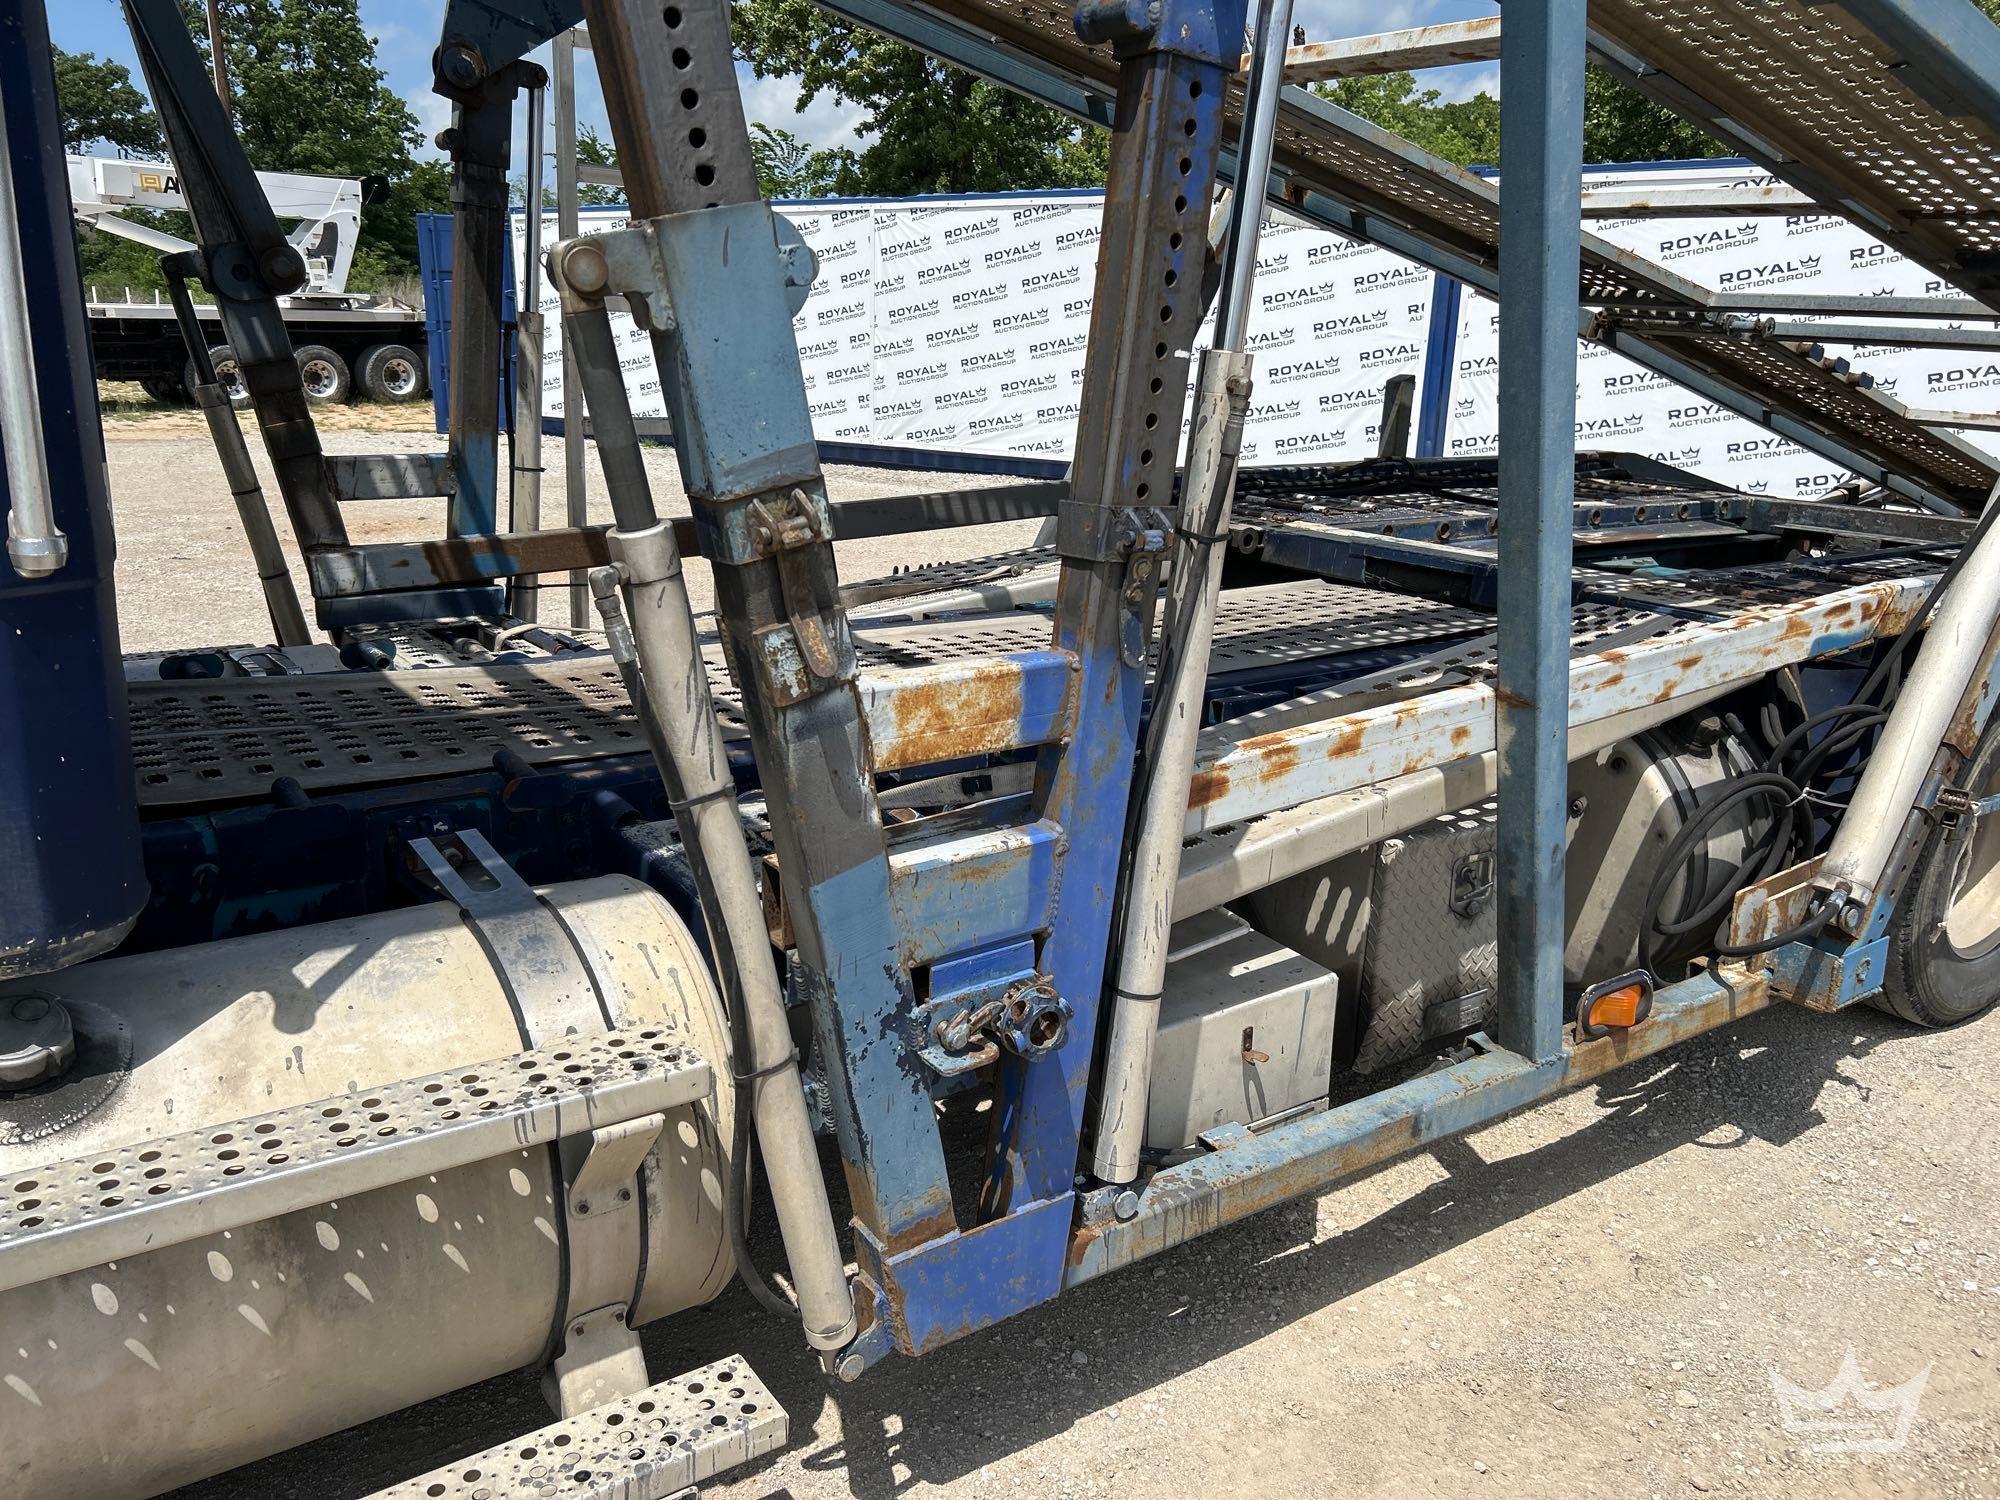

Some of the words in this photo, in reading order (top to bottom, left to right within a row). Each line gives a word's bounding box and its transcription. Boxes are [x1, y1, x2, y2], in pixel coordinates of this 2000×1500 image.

[834, 217, 860, 228] AUCTION
[912, 211, 940, 221] AUCTION
[1015, 216, 1045, 227] AUCTION
[1047, 208, 1072, 219] GROUP
[877, 222, 898, 231] GROUP
[944, 222, 987, 240] ROYAL
[1787, 220, 1844, 236] AUCTION
[946, 235, 975, 246] AUCTION
[976, 228, 1000, 238] GROUP
[1056, 226, 1101, 245] ROYAL
[1660, 229, 1737, 252] ROYAL
[817, 244, 846, 258] OYAL
[881, 240, 920, 256] ROYAL
[1058, 240, 1089, 251] AUCTION
[1308, 240, 1360, 258] ROYA
[1661, 245, 1714, 261] AUCTION
[1716, 236, 1758, 250] GROUP
[819, 256, 836, 264] CTION
[837, 250, 858, 259] GROUP
[882, 252, 908, 262] AUCTION
[910, 246, 932, 255] GROUP
[985, 245, 1029, 262] ROYAL
[986, 258, 1016, 269] AUCTION
[1018, 252, 1042, 262] GROUP
[1309, 252, 1348, 266] AUCTION
[841, 269, 870, 283] ROYA
[918, 262, 959, 280] ROYAL
[920, 274, 947, 285] AUCTION
[948, 268, 972, 278] GROUP
[1259, 266, 1289, 276] GROUP
[1354, 267, 1413, 286] ROYAL
[1720, 261, 1798, 284] ROYAL
[843, 280, 868, 289] AUCTION
[874, 279, 894, 290] YAL
[1022, 270, 1067, 288] ROYAL
[1024, 283, 1054, 294] AUCTION
[1056, 277, 1080, 287] GROUP
[1721, 278, 1774, 293] AUCTION
[1778, 270, 1822, 282] GROUP
[810, 289, 830, 297] GROUP
[886, 285, 906, 294] GROUP
[1356, 282, 1396, 294] AUCTION
[952, 288, 996, 304] ROYAL
[954, 300, 984, 310] AUCTION
[984, 294, 1008, 304] GROUP
[1263, 286, 1318, 305] ROYAL
[1064, 298, 1092, 312] ROY
[1264, 301, 1302, 312] AUCTION
[1304, 294, 1335, 305] GROUP
[818, 306, 855, 320] ROYAL
[888, 305, 929, 318] ROYAL
[890, 315, 917, 325] AUCTION
[919, 310, 940, 320] GROUP
[1066, 310, 1092, 319] AUCTIO
[820, 318, 844, 326] AUCTION
[846, 312, 866, 320] GROUP
[993, 312, 1036, 328] ROYAL
[994, 324, 1024, 334] AUCTION
[1026, 318, 1050, 328] GROUP
[1314, 314, 1372, 332] ROYAL
[926, 326, 967, 342] ROYAL
[1314, 328, 1354, 340] AUCTION
[1356, 322, 1388, 333] GROUP
[928, 338, 955, 348] AUCTION
[957, 334, 980, 343] GROUP
[1030, 337, 1074, 353] ROYAL
[1245, 332, 1280, 346] YAL
[1265, 340, 1295, 349] GROUP
[800, 343, 828, 354] OYAL
[819, 349, 838, 357] GROUP
[874, 341, 902, 353] OYAL
[874, 350, 892, 360] CTION
[894, 348, 914, 356] GROUP
[1031, 350, 1062, 360] AUCTION
[1063, 345, 1088, 354] GROUP
[1360, 343, 1420, 362] ROYAL
[620, 357, 642, 368] OYAL
[961, 352, 1003, 368] ROYAL
[962, 364, 992, 373] AUCTION
[992, 358, 1016, 368] GROUP
[1360, 358, 1401, 369] AUCTION
[826, 366, 862, 379] ROYAL
[897, 366, 936, 380] ROYAL
[1268, 361, 1324, 378] ROYAL
[1270, 374, 1308, 384] AUCTION
[1310, 368, 1340, 380] GROUP
[1460, 369, 1490, 379] CTION
[1928, 365, 2000, 384] ROYA
[640, 381, 660, 391] ROY
[828, 376, 853, 384] AUCTION
[898, 377, 925, 386] AUCTION
[926, 372, 948, 381] GROUP
[1001, 377, 1044, 392] ROYAL
[1604, 372, 1663, 388] ROYA
[1002, 389, 1032, 398] AUCTION
[1034, 384, 1057, 393] GROUP
[1606, 384, 1654, 396] AUCTION
[1929, 381, 1990, 394] AUCTION
[935, 390, 976, 404] ROYAL
[936, 402, 964, 410] AUCTION
[965, 397, 988, 406] GROUP
[1320, 389, 1376, 405] ROYAL
[809, 402, 836, 412] OYAL
[874, 402, 909, 415] ROYAL
[1037, 404, 1080, 418] ROYAL
[1245, 404, 1285, 417] OYAL
[1321, 402, 1359, 412] AUCTION
[1455, 410, 1475, 418] OUP
[875, 412, 901, 421] AUCTION
[902, 408, 923, 418] GROUP
[1038, 416, 1068, 424] AUCTION
[1244, 416, 1270, 424] CTION
[1272, 412, 1300, 420] GROUP
[969, 416, 1011, 429] ROYAL
[1575, 418, 1623, 432] OYAL
[1670, 416, 1720, 428] AUCTION
[906, 427, 945, 440] ROYAL
[970, 426, 1000, 436] AUCTION
[1000, 423, 1024, 432] GROUP
[1606, 427, 1644, 437] GROUP
[1275, 433, 1330, 449] ROYAL
[1276, 444, 1314, 456] AUCTION
[1316, 440, 1346, 452] GROUP
[1452, 435, 1500, 450] ROYA
[1727, 438, 1791, 454] ROYA
[1453, 446, 1496, 456] AUCTION
[1728, 451, 1780, 462] AUCTION
[1796, 473, 1846, 488] ROY
